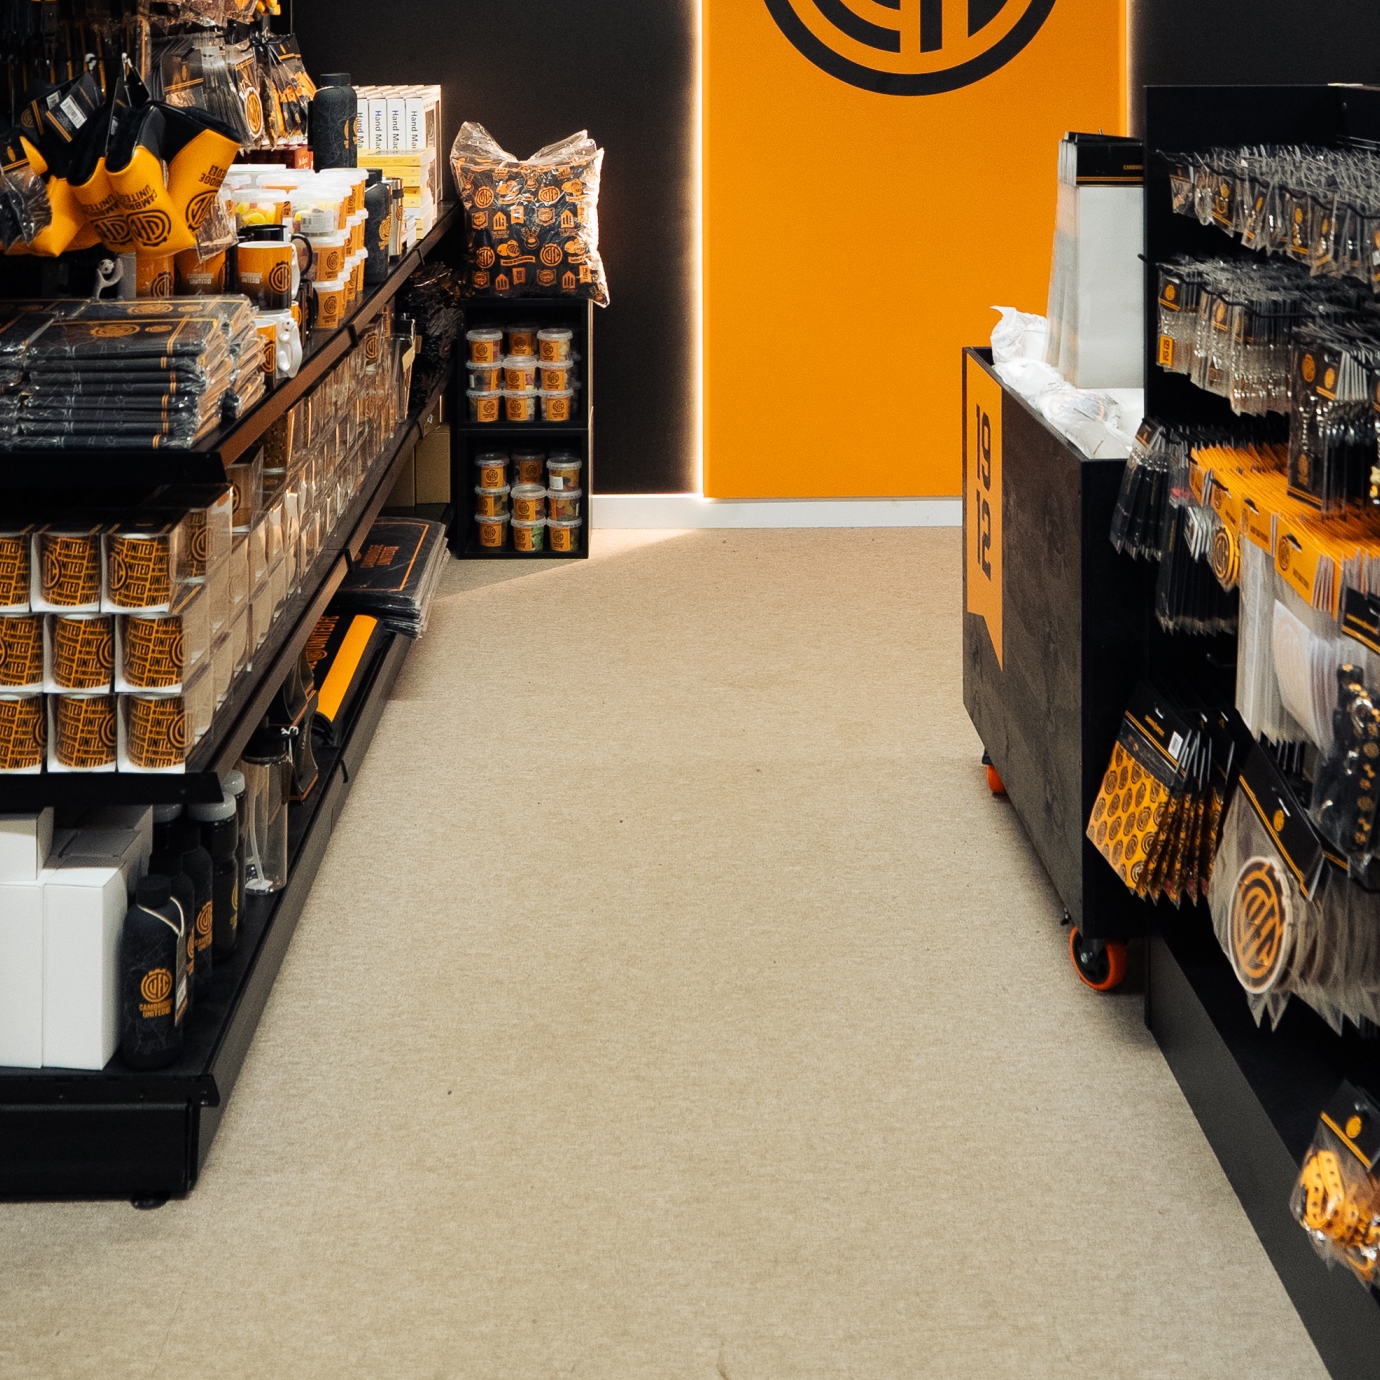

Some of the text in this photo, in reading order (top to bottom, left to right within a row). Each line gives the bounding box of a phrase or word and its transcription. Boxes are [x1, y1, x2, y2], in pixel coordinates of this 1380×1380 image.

[375, 110, 383, 131] Hand
[975, 403, 992, 492] 19
[976, 489, 992, 582] 12
[60, 540, 88, 554] UNITED
[125, 541, 153, 555] UNITED
[5, 621, 34, 633] UNITED
